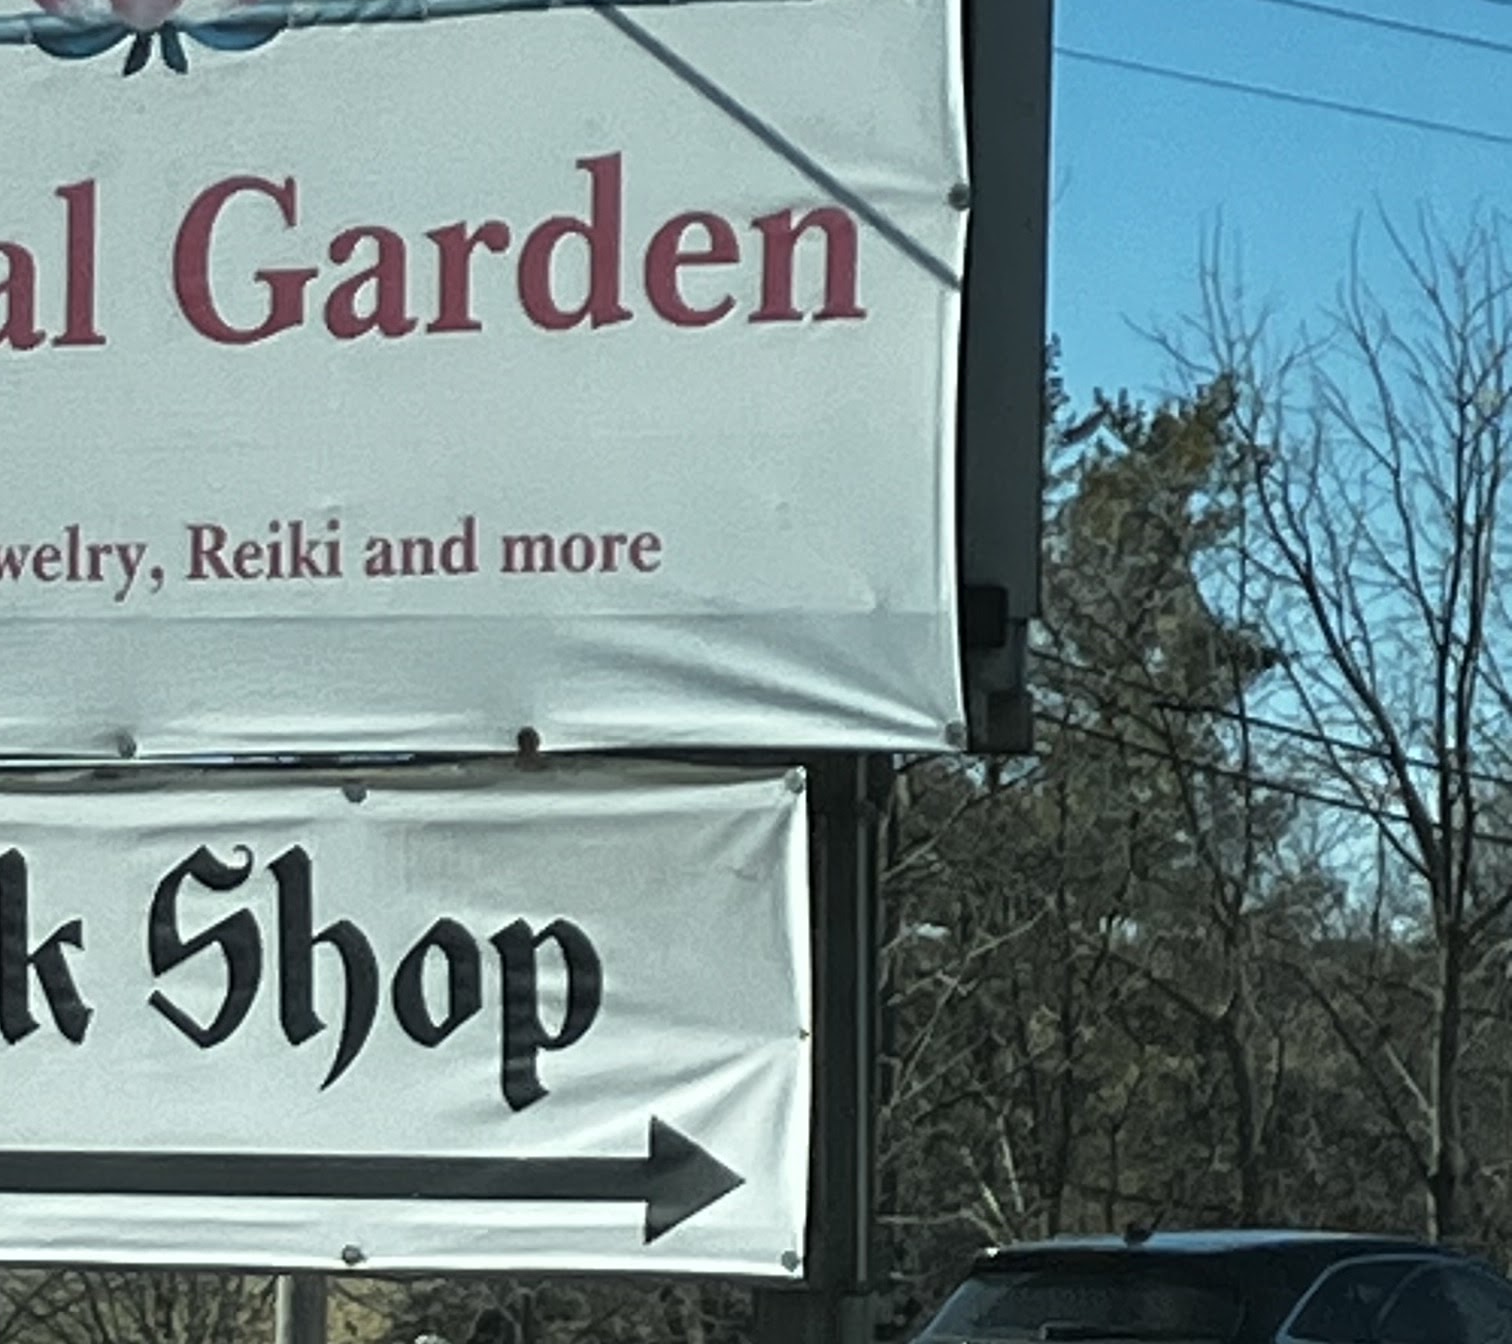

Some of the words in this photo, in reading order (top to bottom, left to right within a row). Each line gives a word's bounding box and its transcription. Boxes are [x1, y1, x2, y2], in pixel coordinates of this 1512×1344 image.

[171, 152, 868, 347] Garden
[185, 518, 343, 581] Reiki
[363, 514, 479, 578] and
[499, 528, 663, 574] more
[148, 845, 603, 1113] Shop
